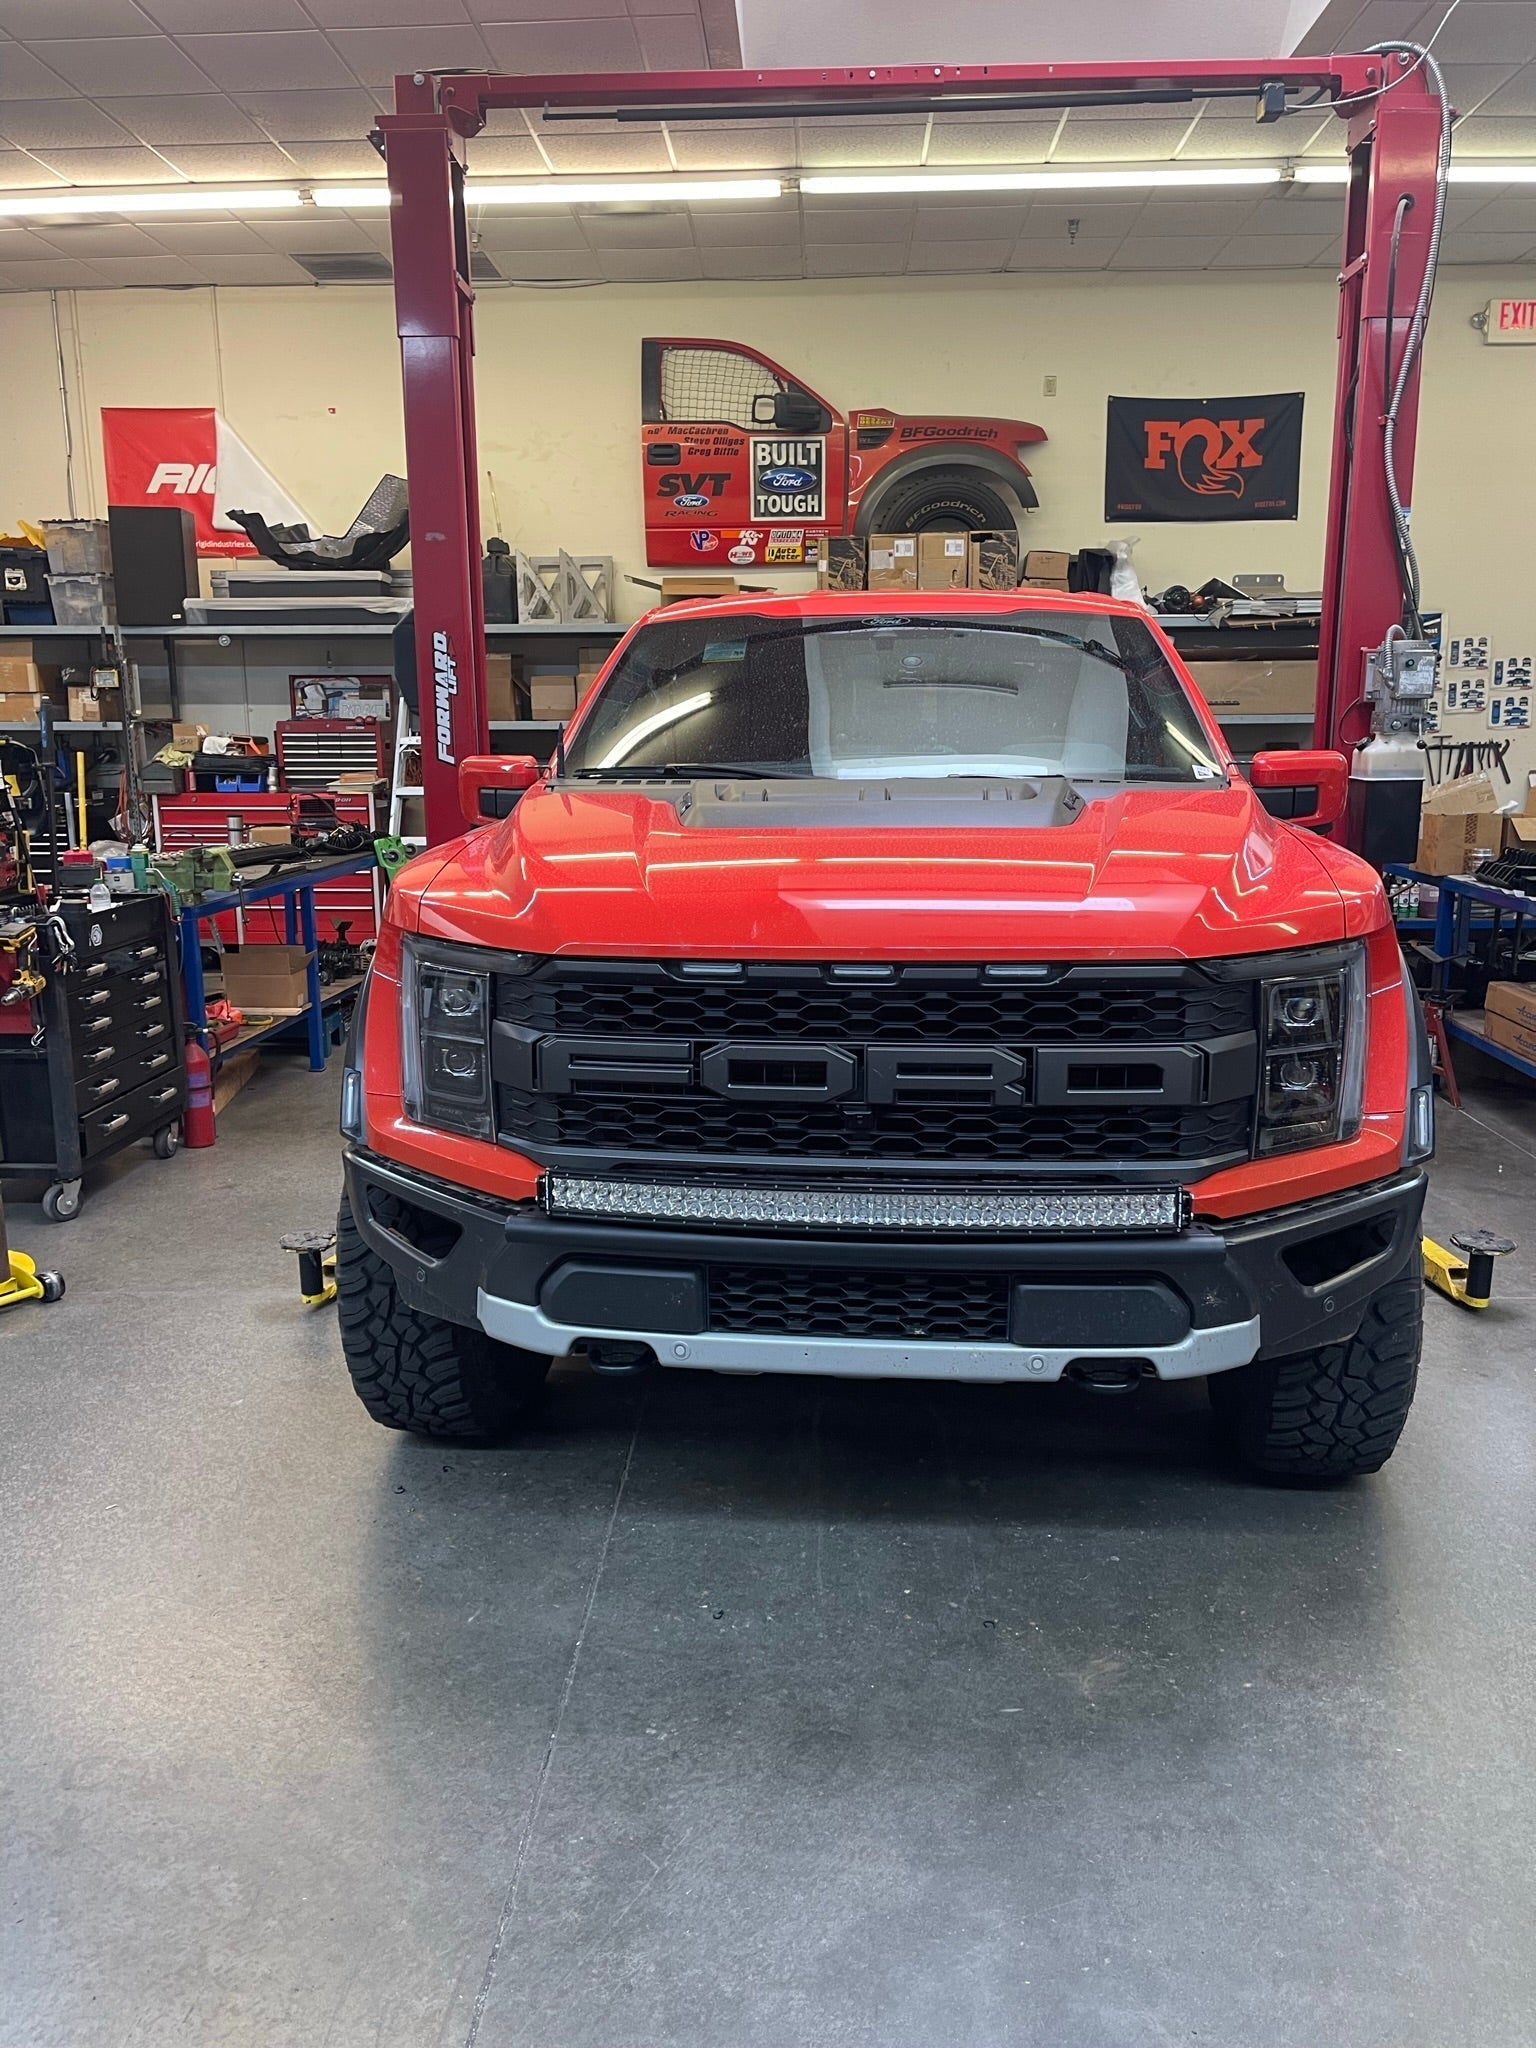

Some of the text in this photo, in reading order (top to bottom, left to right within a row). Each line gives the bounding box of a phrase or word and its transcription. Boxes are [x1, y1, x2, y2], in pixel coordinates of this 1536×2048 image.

[1500, 302, 1536, 329] EXIT
[900, 426, 998, 439] BFGoodrich
[687, 446, 740, 457] Greg Biffle
[756, 442, 820, 466] BUILT
[1144, 418, 1265, 498] FOX
[656, 473, 731, 497] SVT
[773, 472, 804, 487] Ford
[679, 496, 703, 507] Ford
[756, 494, 819, 513] TOUGH
[664, 510, 719, 518] RACING
[905, 500, 987, 528] BFGoodrich
[195, 540, 256, 549] rigidindustries.co
[447, 656, 458, 696] LIFT
[433, 630, 456, 765] FORWARD
[536, 1034, 1205, 1106] FORD
